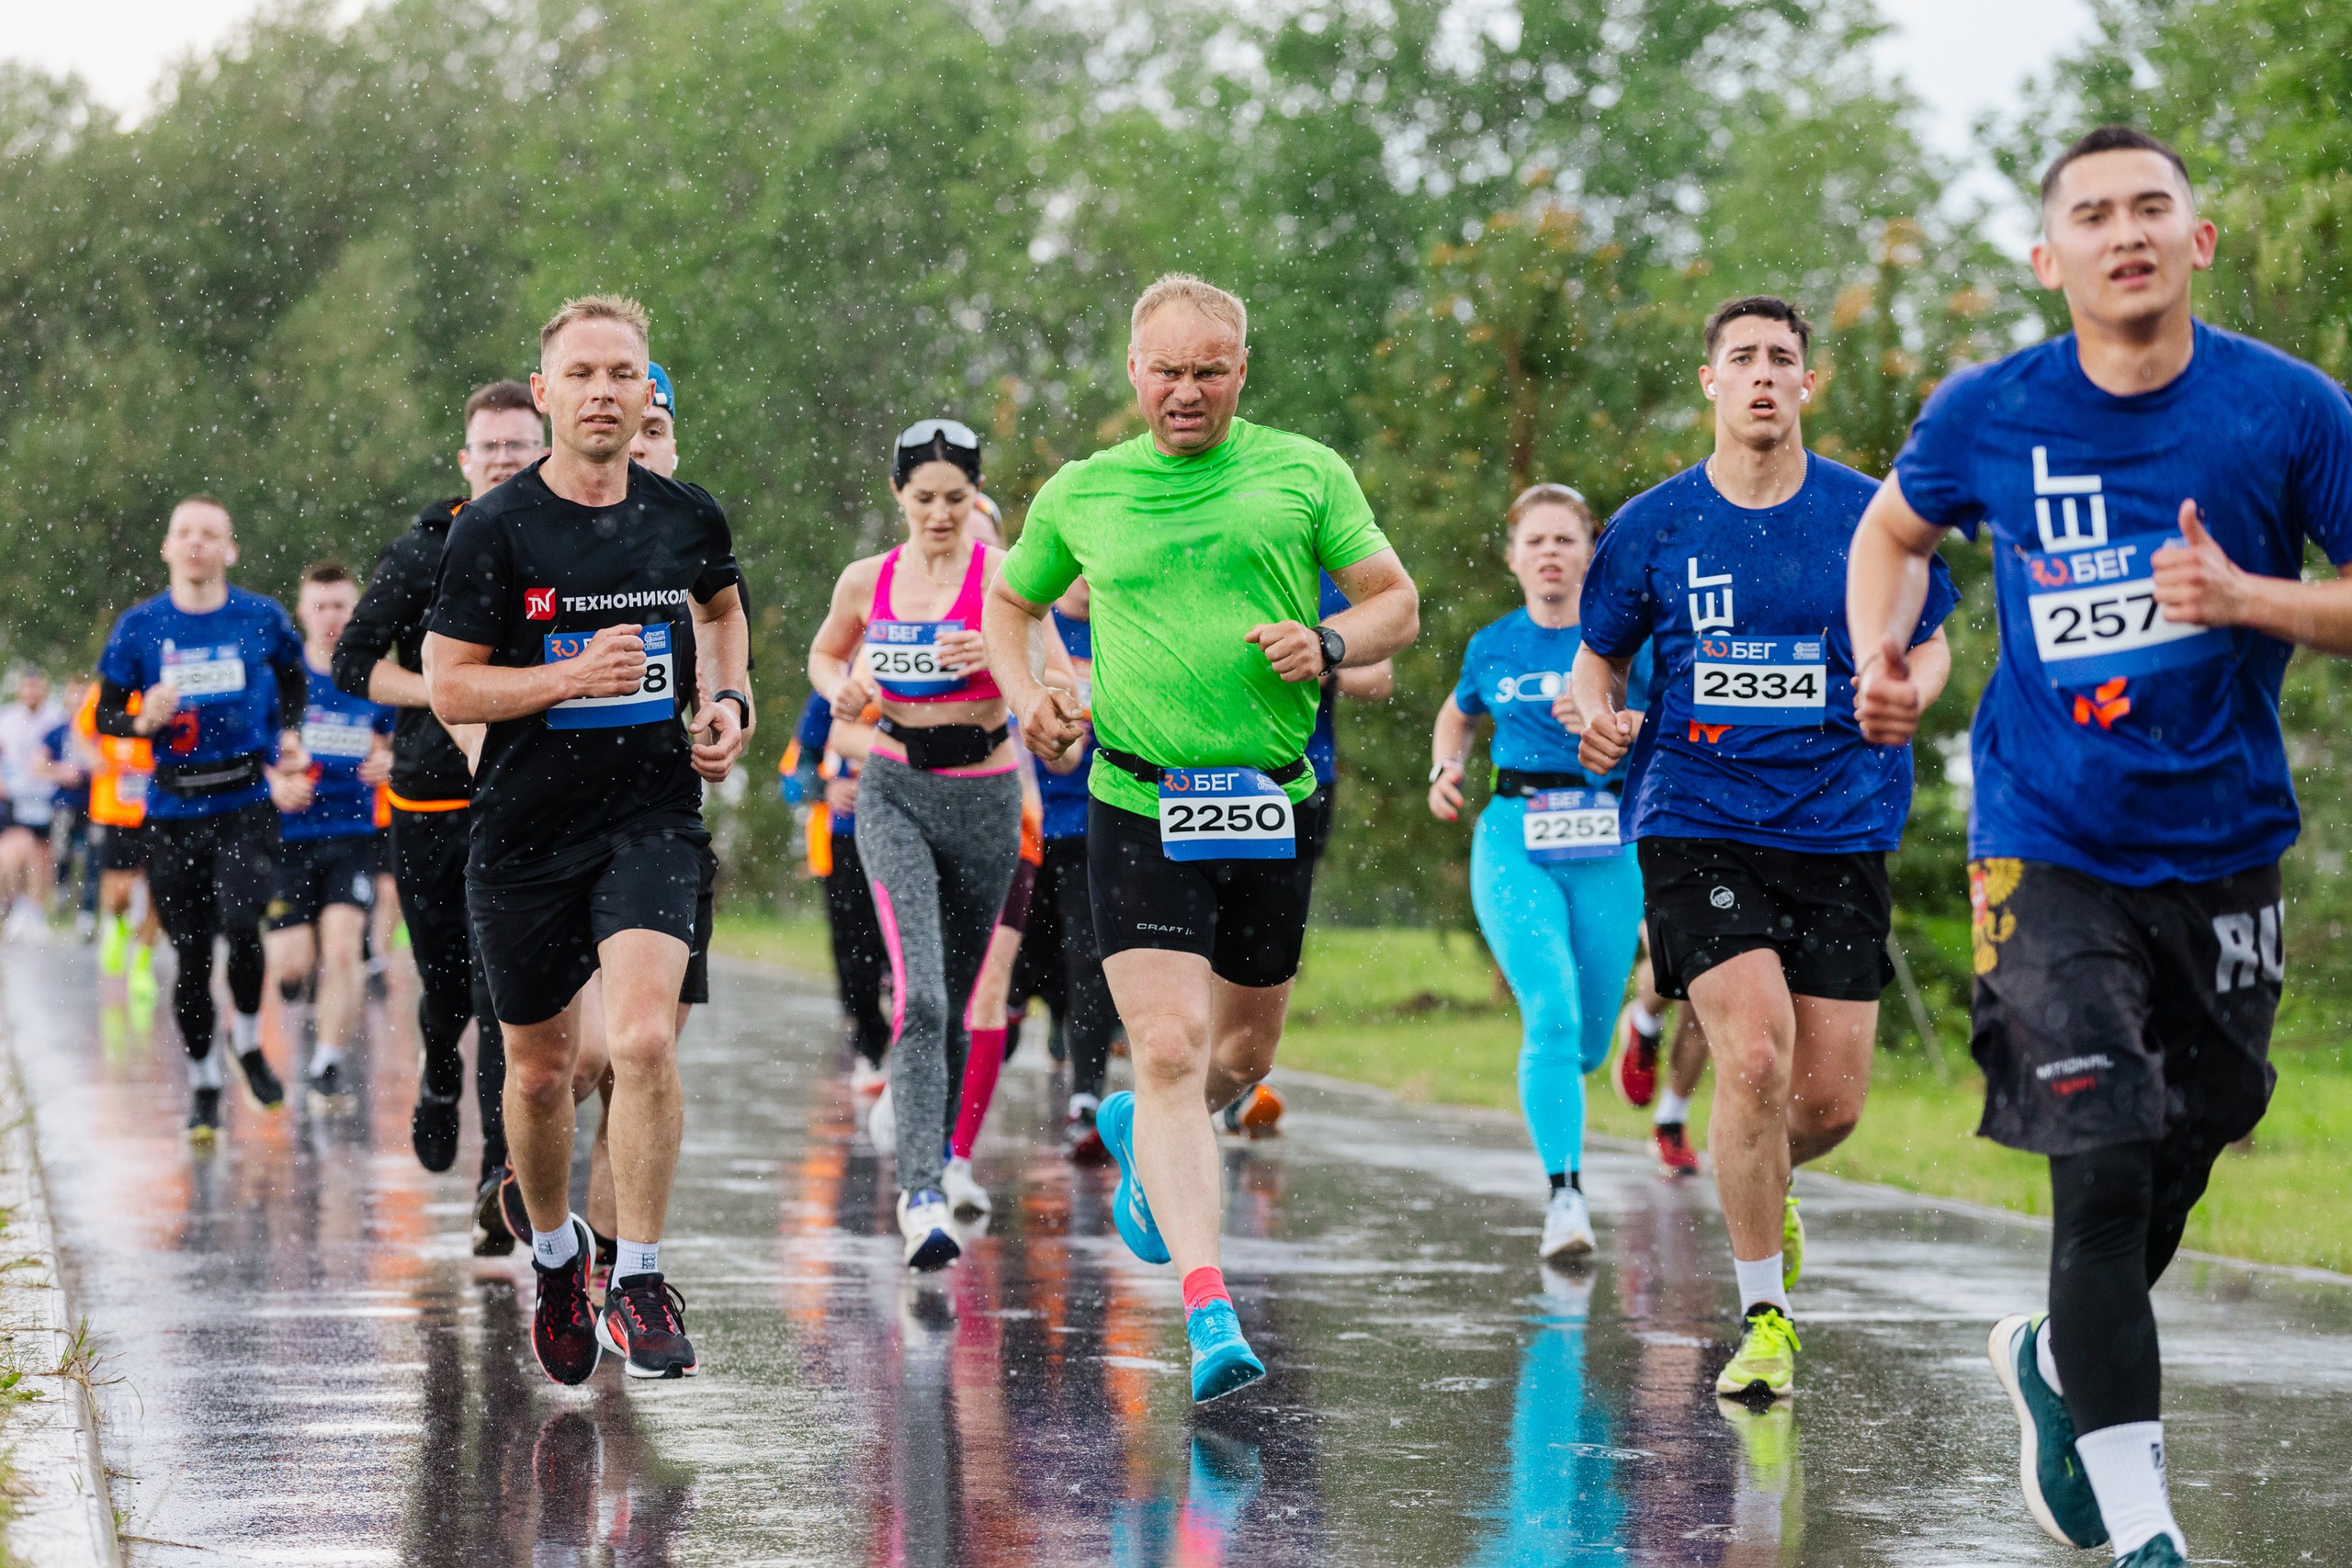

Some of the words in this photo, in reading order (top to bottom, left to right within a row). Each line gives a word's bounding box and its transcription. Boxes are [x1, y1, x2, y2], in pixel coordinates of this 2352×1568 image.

[2031, 446, 2109, 554] ЕГ
[2070, 545, 2137, 584] БЕГ
[1688, 557, 1735, 637] ЕГ
[2049, 592, 2160, 644] 257
[1731, 641, 1778, 660] БЕГ
[1703, 671, 1817, 699] 2334
[1193, 773, 1240, 792] БЕГ
[1168, 803, 1286, 833] 2250
[1532, 815, 1617, 840] 2252
[1136, 922, 1183, 933] CRAFT
